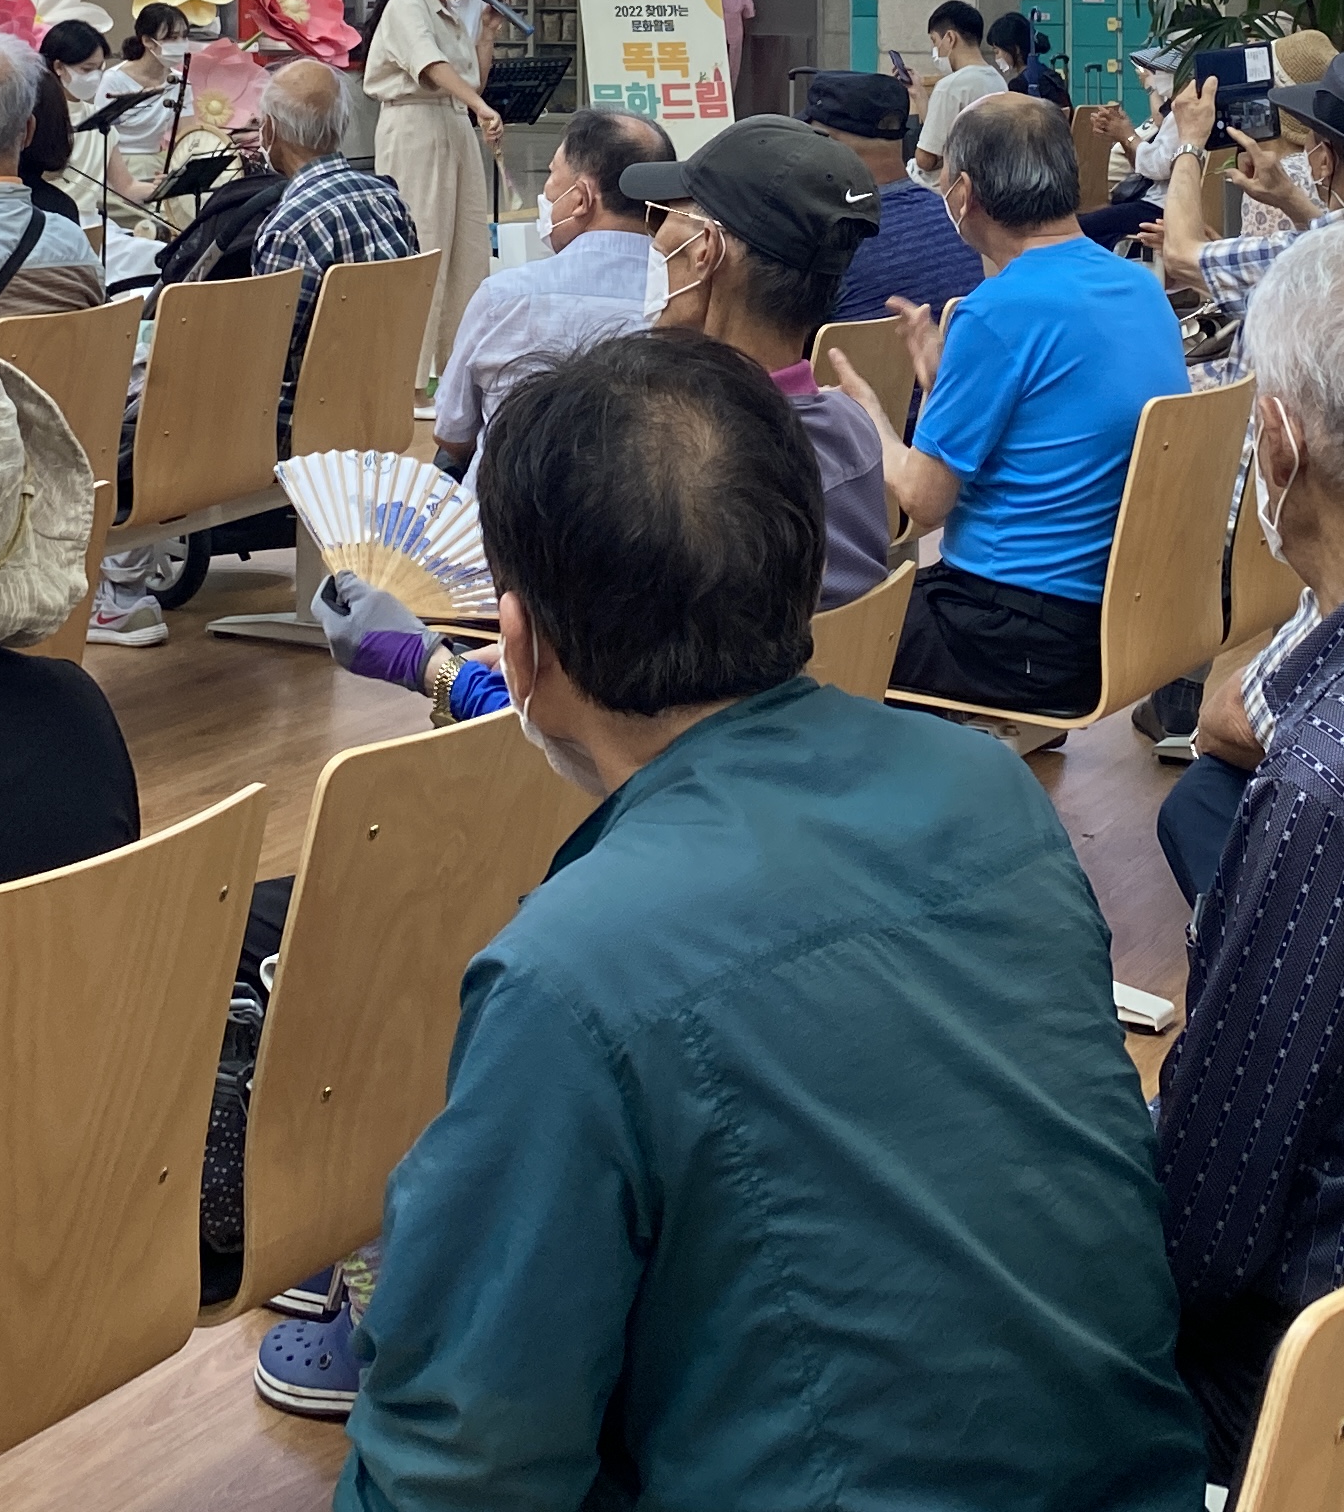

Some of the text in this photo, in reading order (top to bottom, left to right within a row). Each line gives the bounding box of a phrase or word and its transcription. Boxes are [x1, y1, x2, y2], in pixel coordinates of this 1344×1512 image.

[614, 4, 689, 18] 2022 찾아가는
[622, 41, 690, 79] 똑똑
